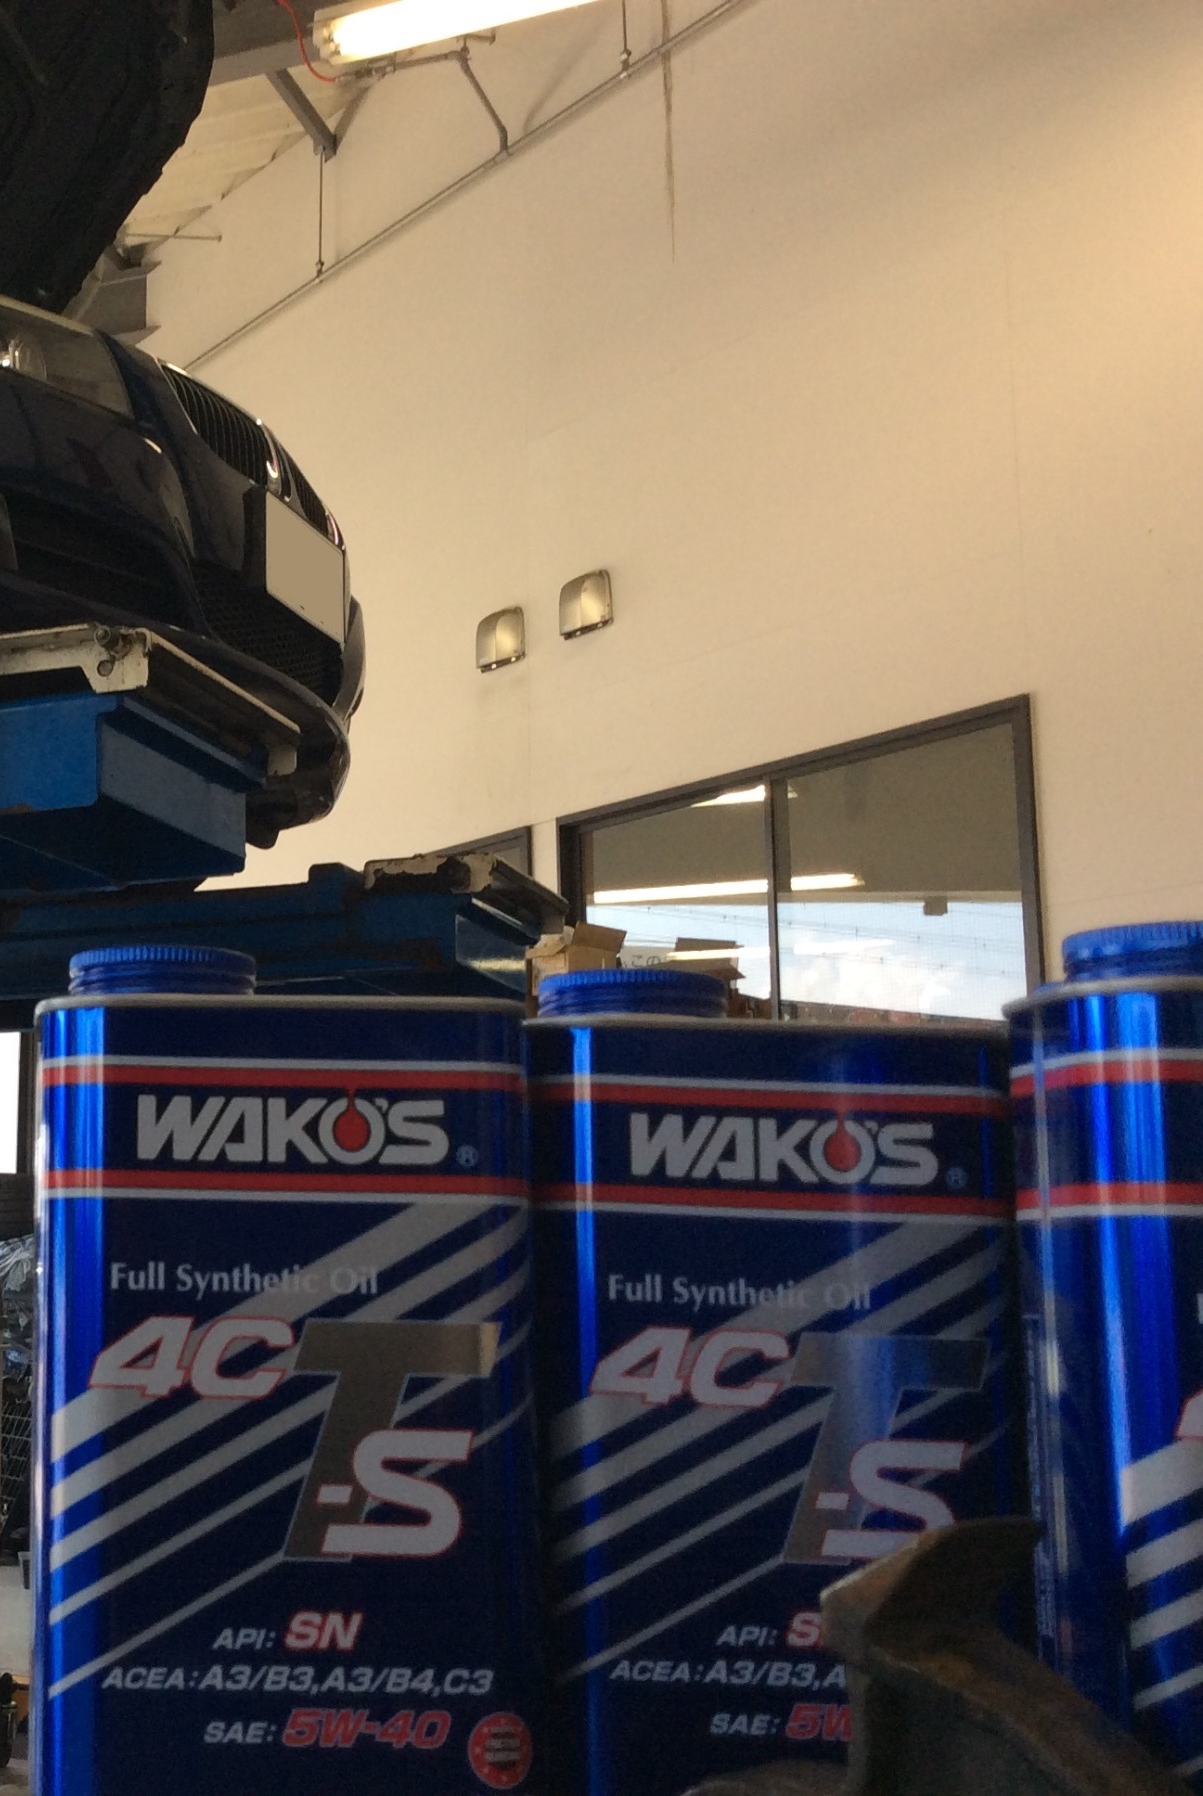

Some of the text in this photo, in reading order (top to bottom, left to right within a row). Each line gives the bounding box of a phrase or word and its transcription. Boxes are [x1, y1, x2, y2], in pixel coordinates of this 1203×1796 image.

[136, 1093, 450, 1166] WAKO'S
[629, 1112, 939, 1186] WAKO'S
[110, 1262, 379, 1301] Full Synthetic Oil
[608, 1273, 872, 1312] Full Synthetic Oil
[213, 1611, 364, 1652] API: SN
[717, 1610, 824, 1648] API: S
[203, 1721, 277, 1745] SAE:
[281, 1707, 453, 1749] 5W-40
[709, 1702, 854, 1741] SAE: 5W
